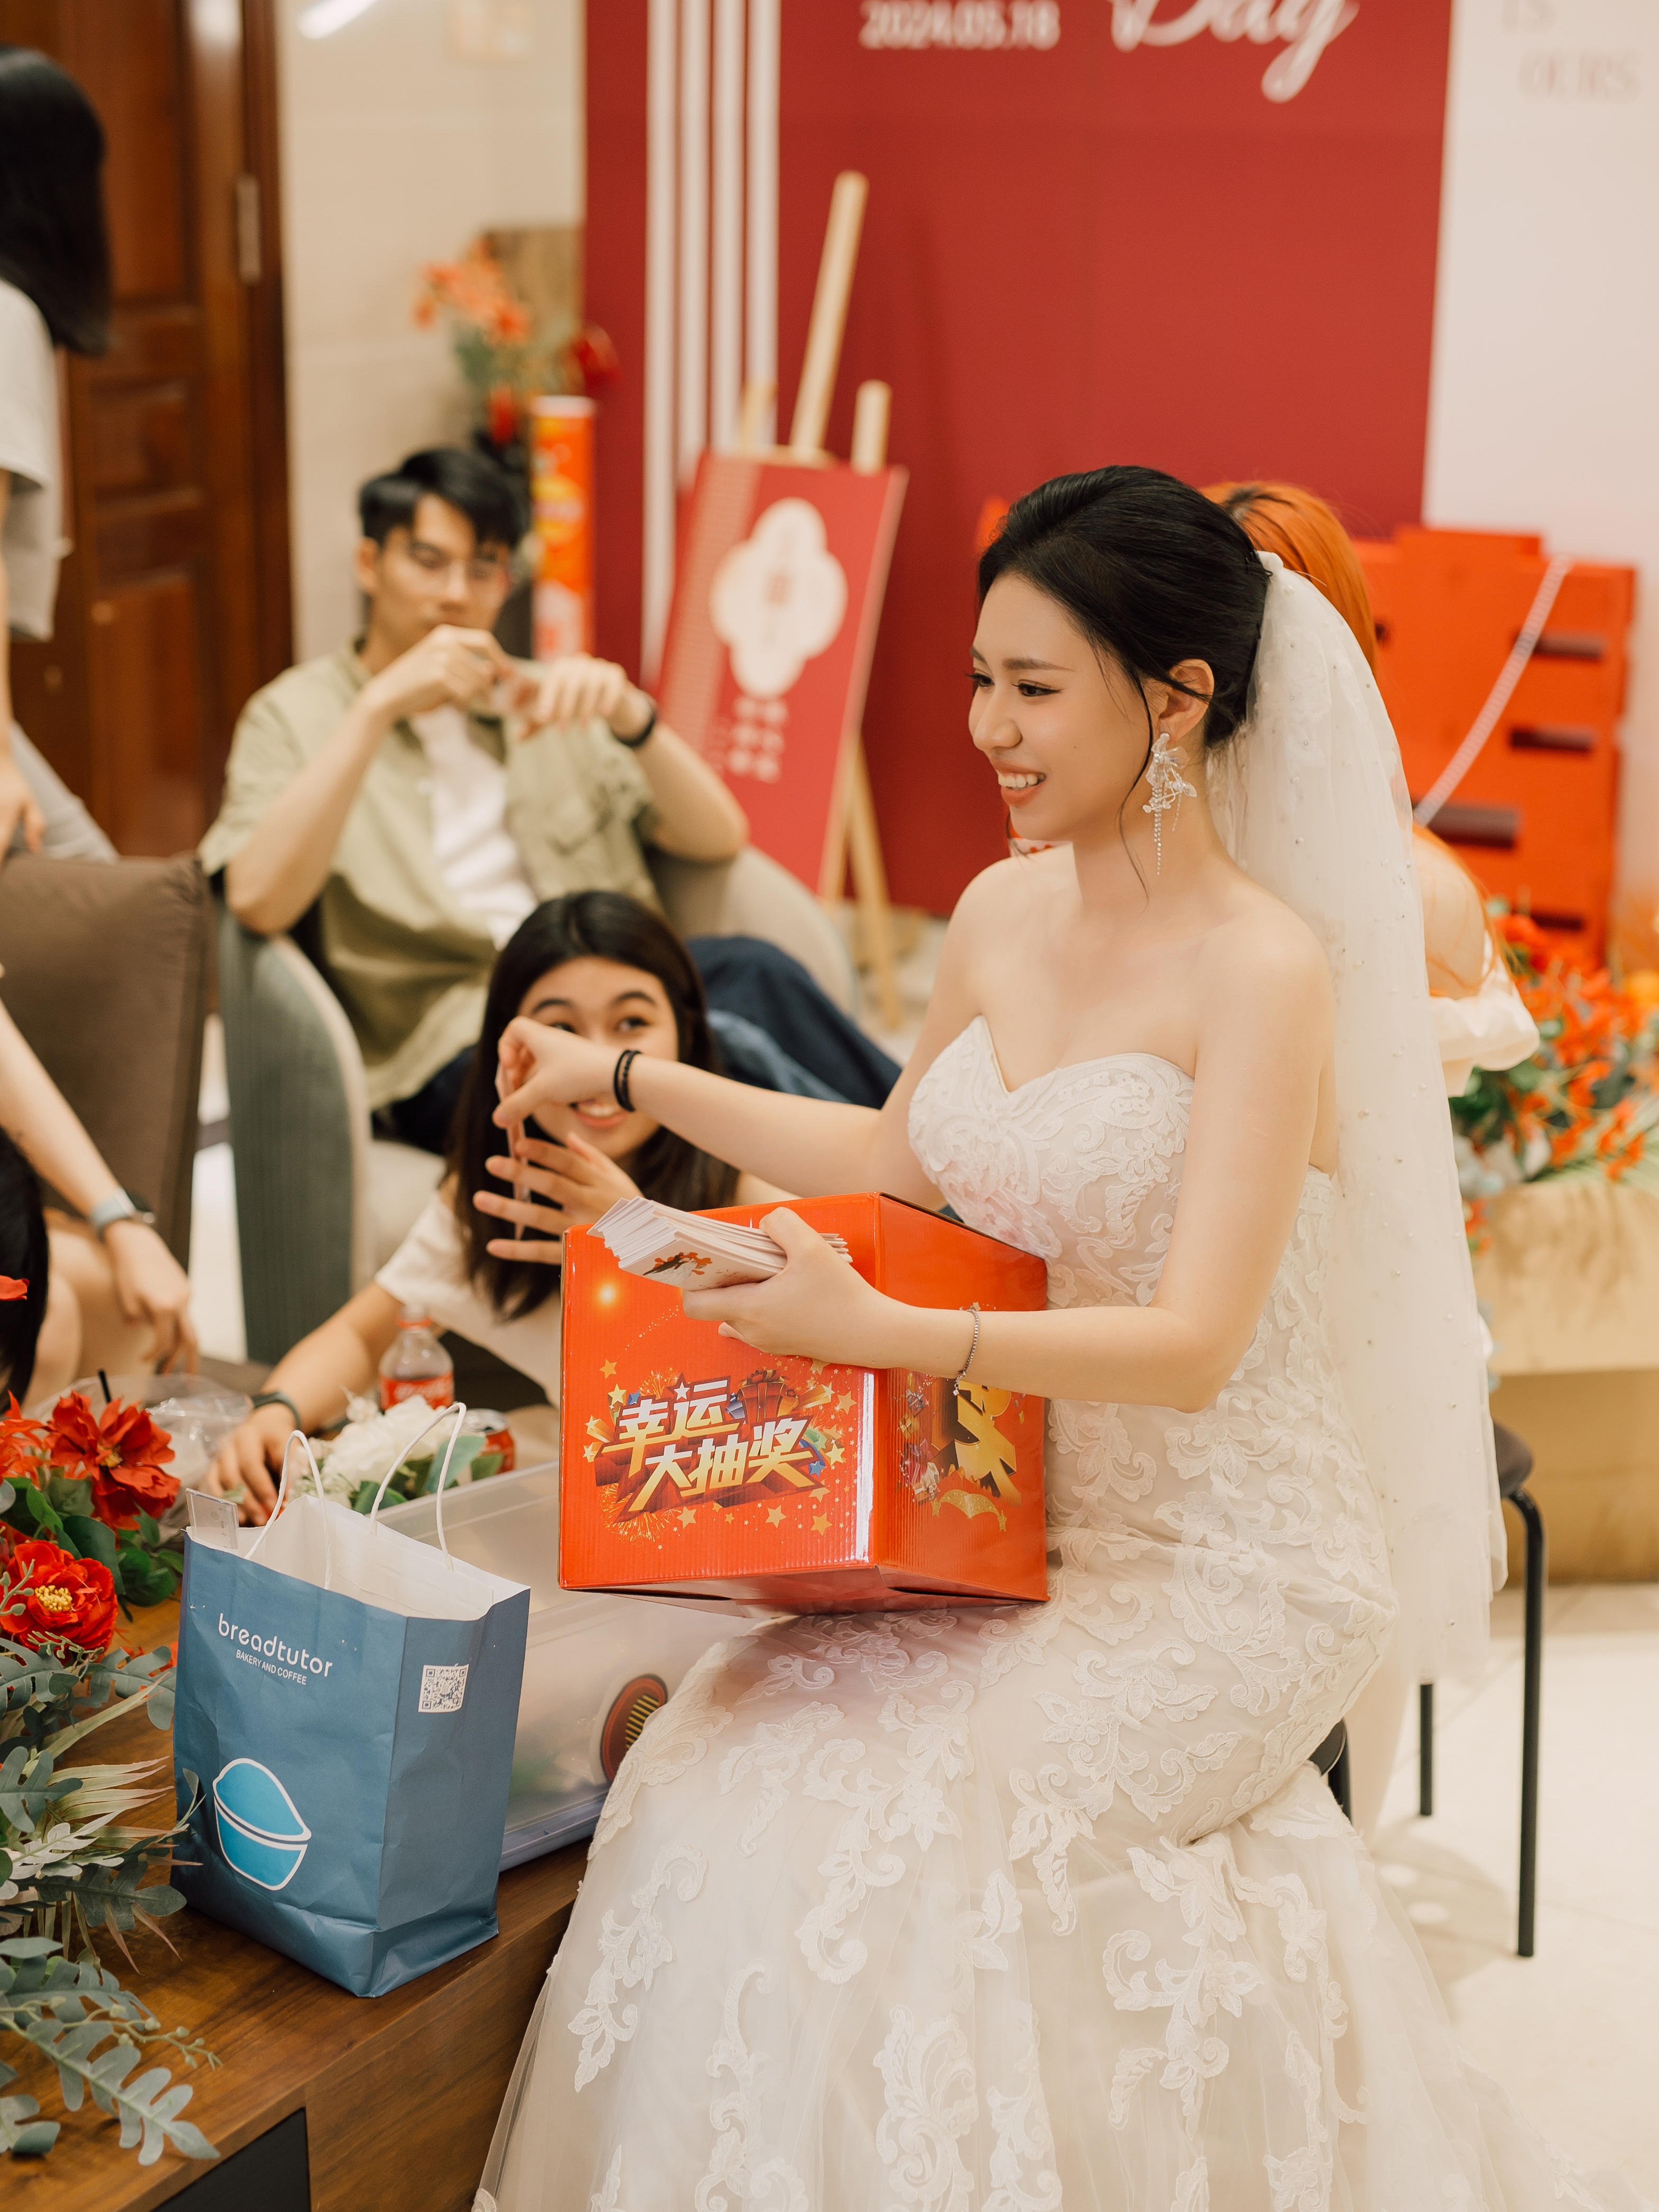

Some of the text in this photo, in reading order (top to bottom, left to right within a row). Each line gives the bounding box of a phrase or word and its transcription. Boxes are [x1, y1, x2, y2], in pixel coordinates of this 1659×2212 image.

[601, 1379, 740, 1478] 幸运
[628, 1417, 816, 1513] 大抽奖
[218, 1612, 333, 1678] breadtutor
[236, 1649, 307, 1685] BAKERY AND COFFEE
